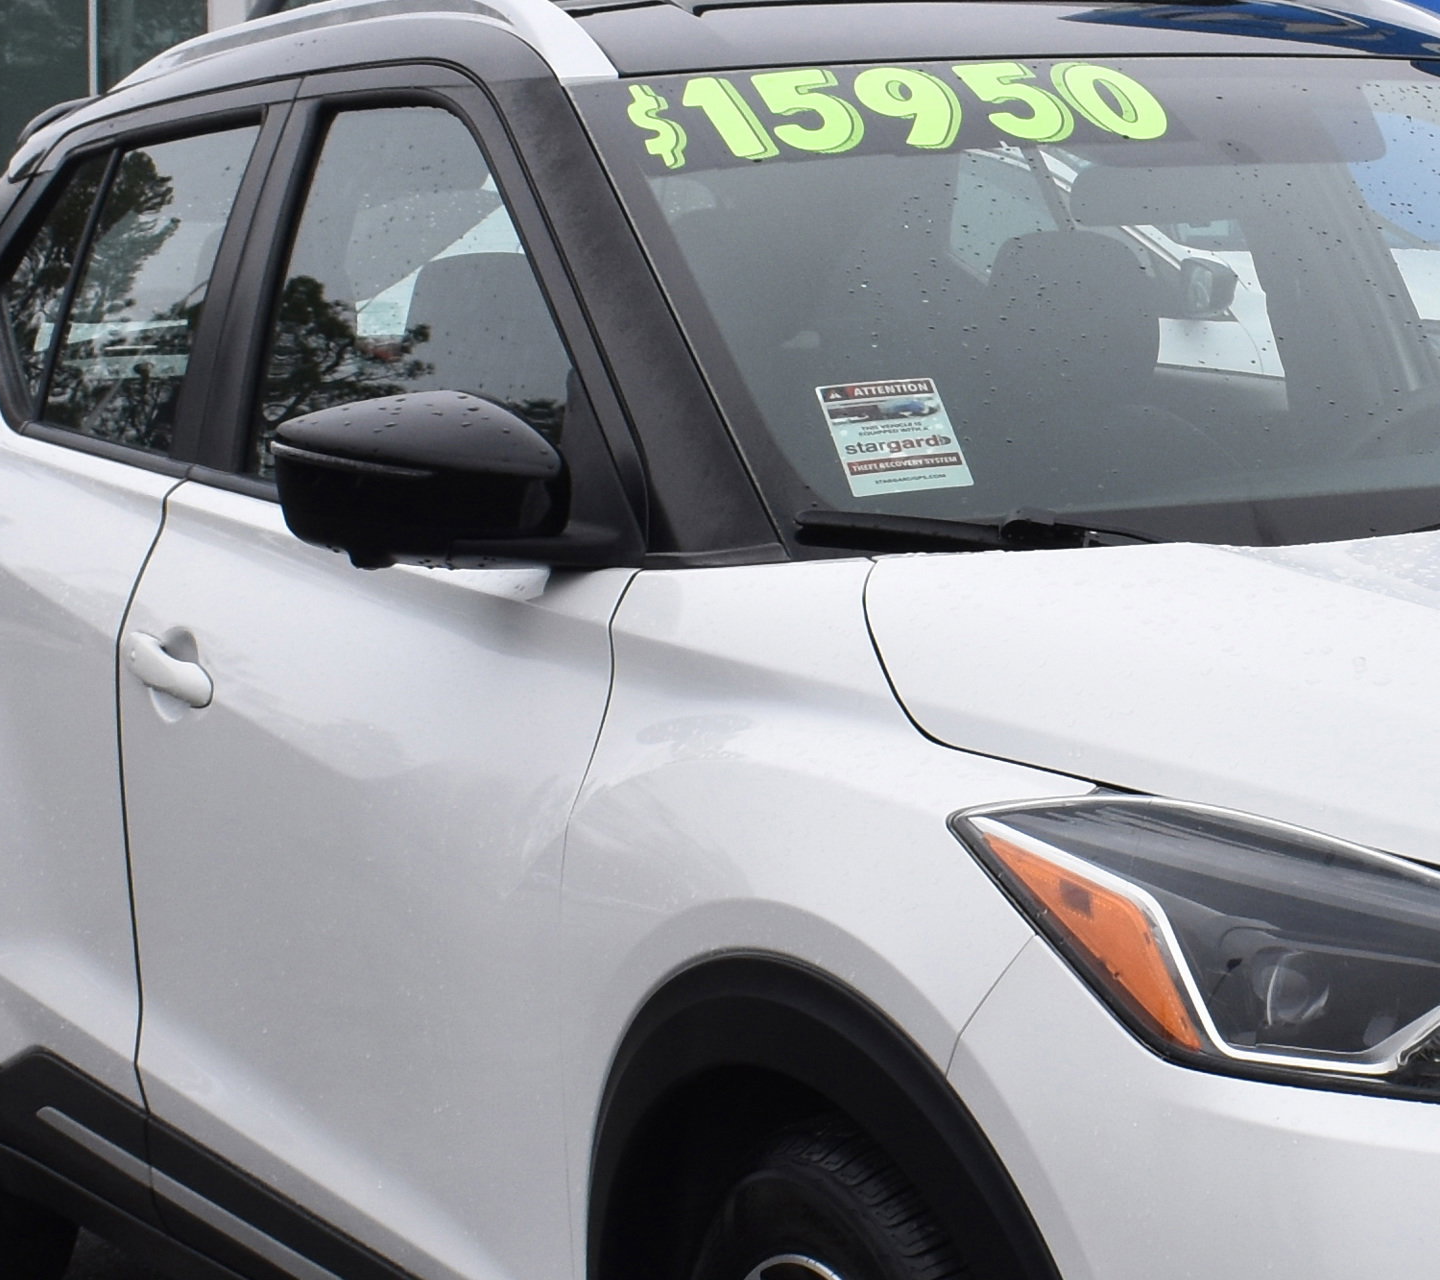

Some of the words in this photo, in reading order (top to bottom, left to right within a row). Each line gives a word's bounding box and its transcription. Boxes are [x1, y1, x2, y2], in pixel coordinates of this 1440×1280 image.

[626, 61, 1168, 169] $15950
[853, 382, 929, 397] ATTENTION
[845, 435, 939, 455] stargard
[851, 463, 878, 472] THEFT
[879, 459, 923, 470] RECOVERY
[923, 456, 958, 465] SYSTEM
